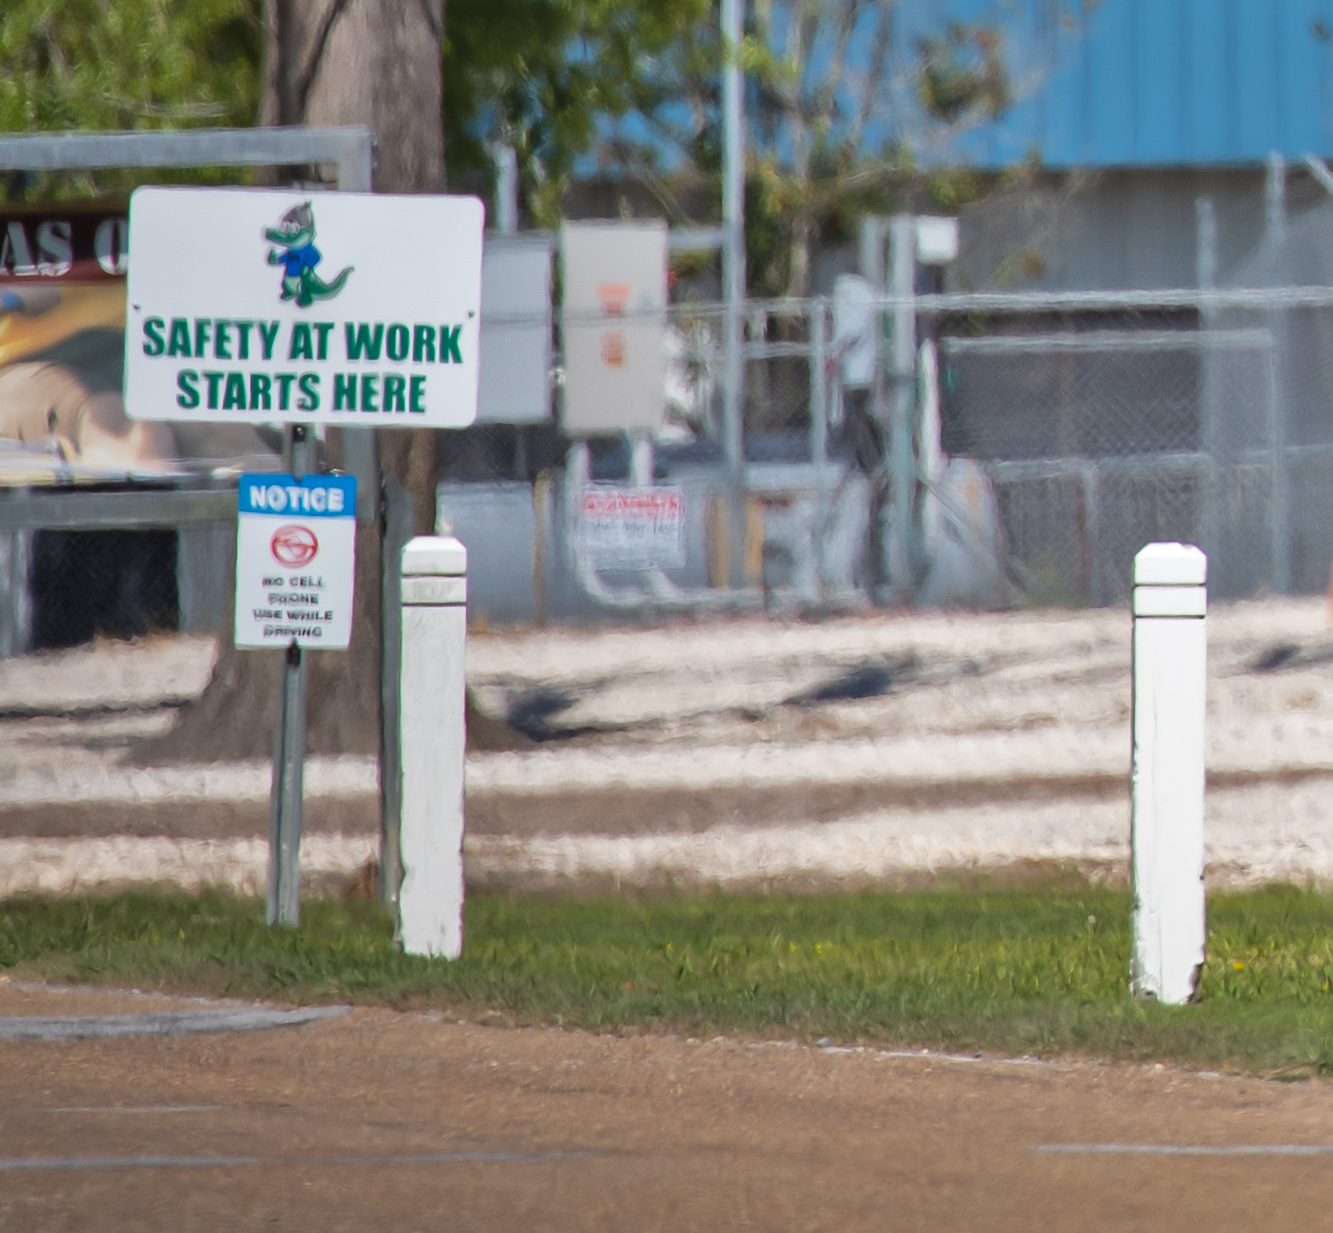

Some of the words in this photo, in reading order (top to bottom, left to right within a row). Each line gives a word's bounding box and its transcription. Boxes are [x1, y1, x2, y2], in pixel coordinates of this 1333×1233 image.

[142, 316, 280, 360] SAFETY
[289, 321, 335, 361] AT
[344, 322, 464, 364] WORK
[176, 369, 321, 412] STARTS
[332, 371, 427, 413] HERE
[250, 485, 345, 513] NOTICE
[262, 577, 285, 588] NO
[289, 577, 325, 588] CELL
[268, 593, 319, 605] PHONE
[253, 609, 283, 620] USE
[287, 610, 334, 622] WHILE
[263, 628, 323, 638] DRIVING
